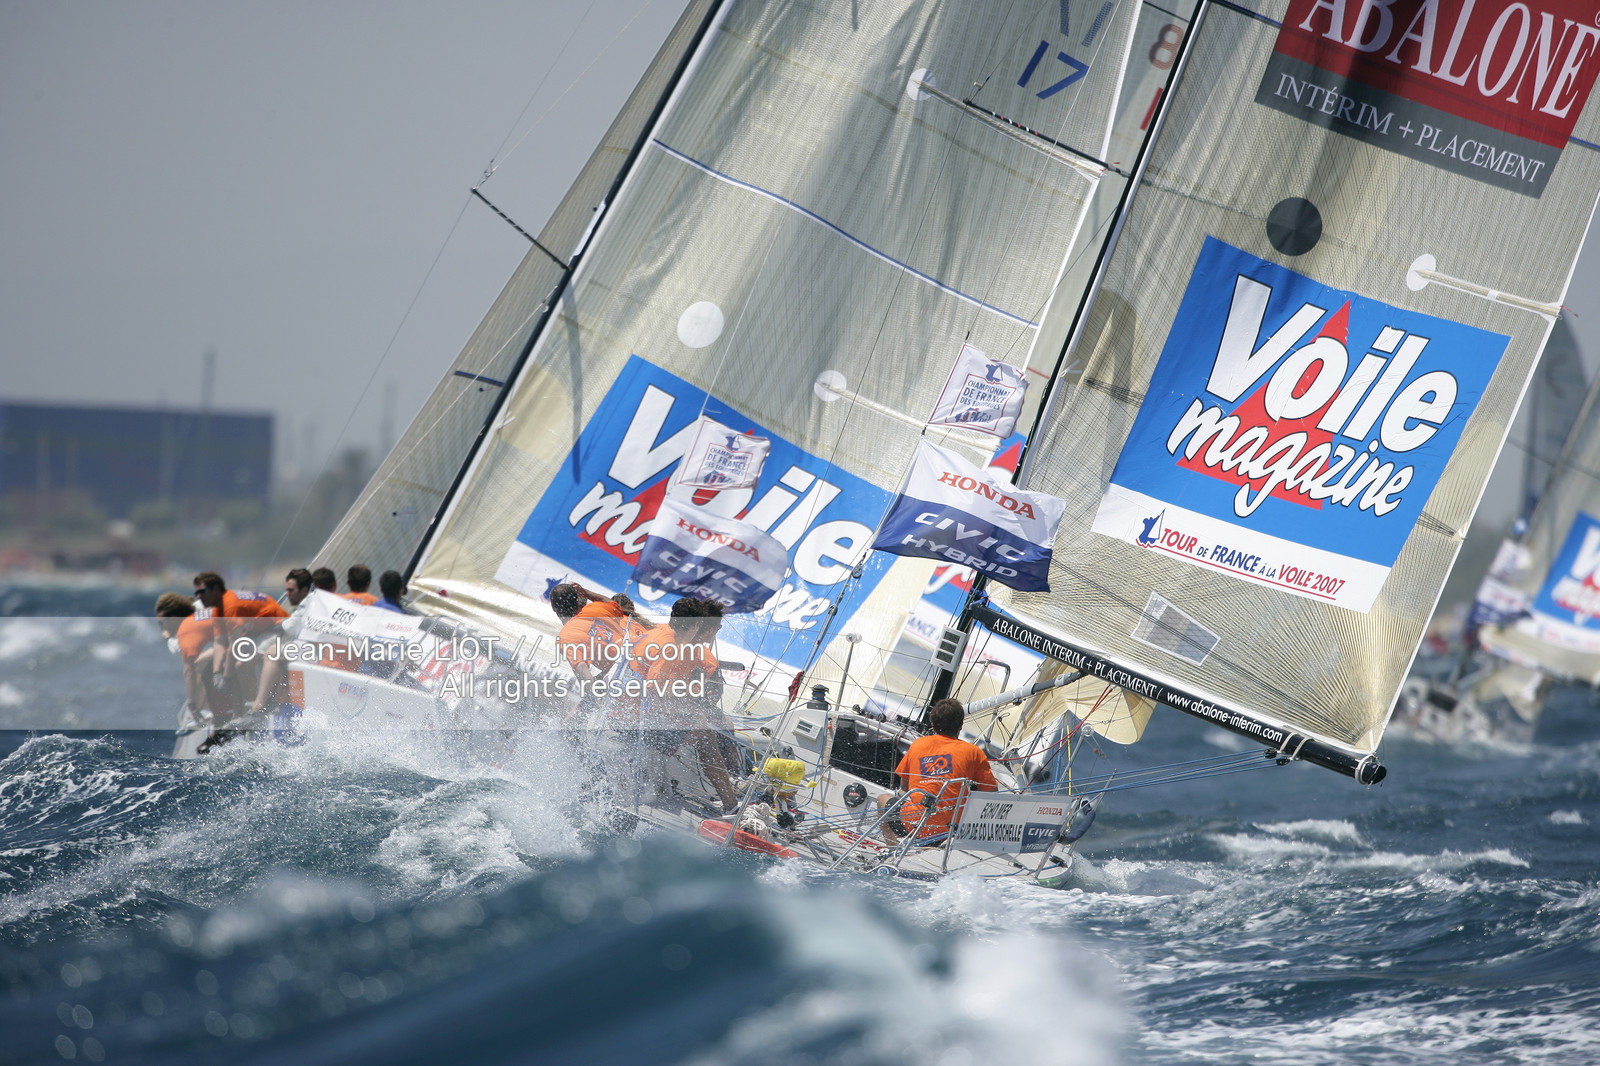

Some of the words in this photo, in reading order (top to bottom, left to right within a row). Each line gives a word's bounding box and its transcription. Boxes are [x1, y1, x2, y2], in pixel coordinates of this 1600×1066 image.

[1017, 40, 1091, 100] 17
[1274, 73, 1396, 135] INTÉRIM
[1399, 120, 1414, 138] +
[1415, 123, 1546, 184] PLACEMENT
[1205, 273, 1459, 453] Voile
[963, 387, 975, 398] DE
[976, 391, 1007, 404] FRANCE
[718, 455, 746, 470] FRANCE
[1166, 397, 1414, 518] magazine
[607, 383, 876, 587] Vile
[937, 471, 1036, 520] HONDA
[676, 517, 761, 563] HONDA
[901, 534, 1018, 578] HYBRID
[914, 512, 1026, 561] CIVIC
[658, 550, 748, 594] CIVIC
[1160, 528, 1198, 553] TOUR
[1197, 546, 1209, 557] DE
[1209, 544, 1261, 573] FRANCE
[1265, 567, 1276, 578] LA
[1278, 564, 1314, 588] VOILE
[1312, 574, 1346, 595] 2007
[993, 618, 1042, 650] ABALONE
[1042, 639, 1085, 669] INTERIM
[1093, 661, 1157, 699] PLACEMENT
[1028, 827, 1056, 838] CIVIC
[1037, 807, 1062, 816] HONDA
